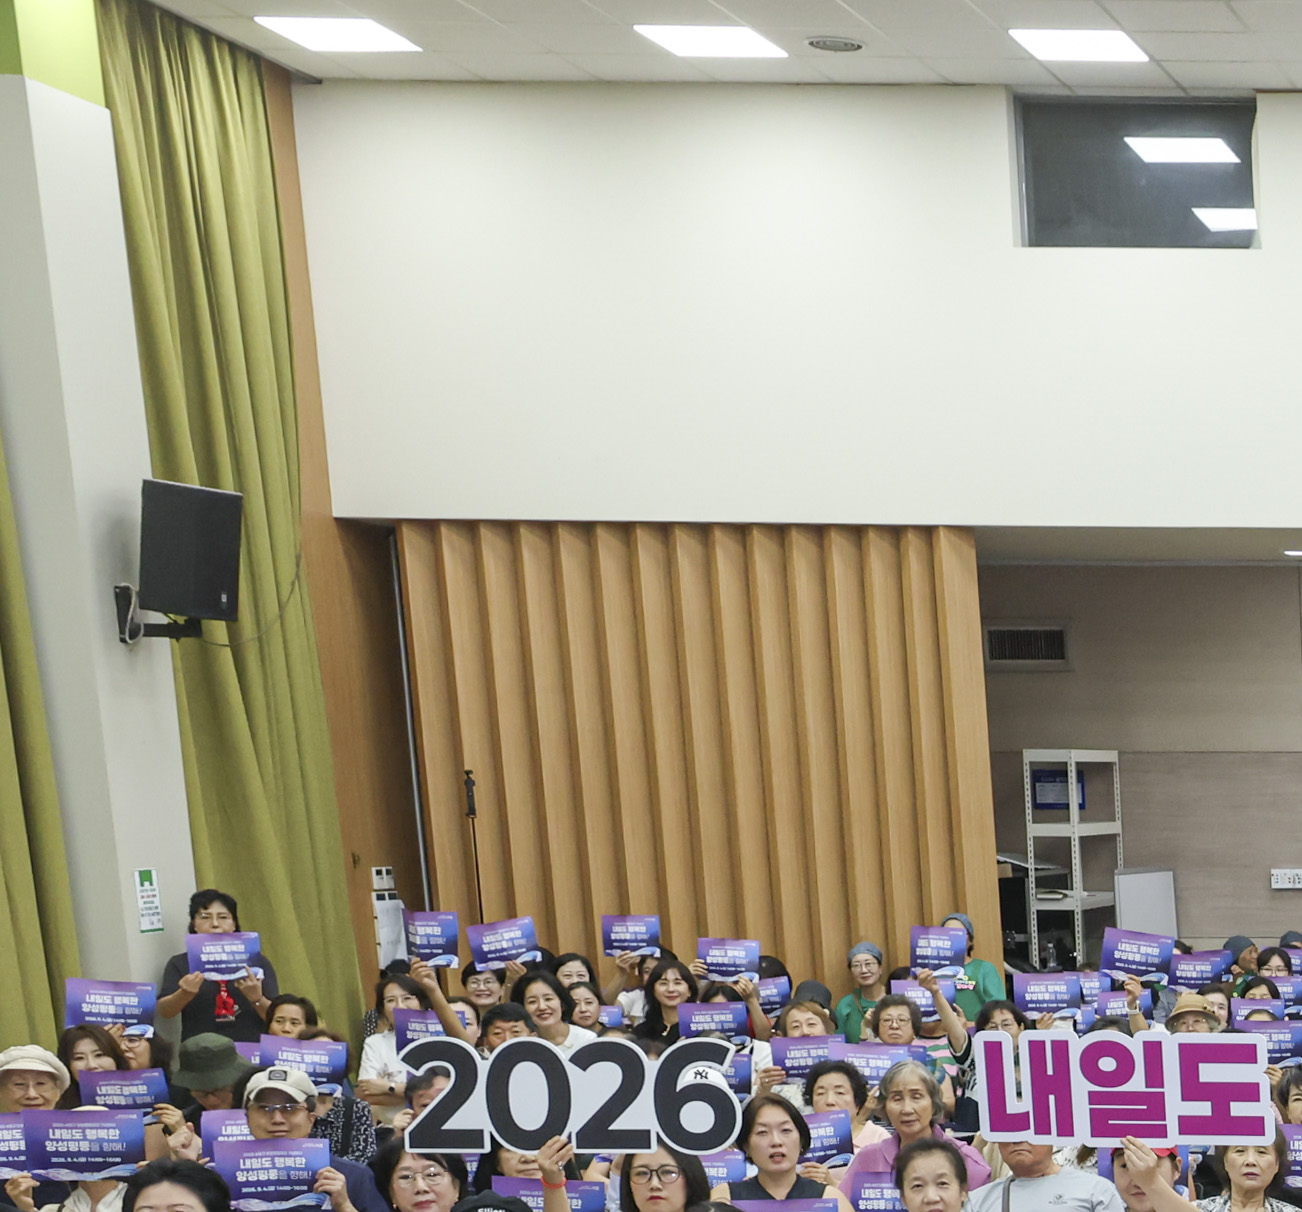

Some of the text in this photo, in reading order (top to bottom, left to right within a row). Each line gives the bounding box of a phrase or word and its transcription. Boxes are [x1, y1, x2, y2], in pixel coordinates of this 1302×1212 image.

[49, 1128, 120, 1140] 내일도 행복한
[406, 1038, 736, 1153] 2026
[984, 1032, 1266, 1141] 내일도
